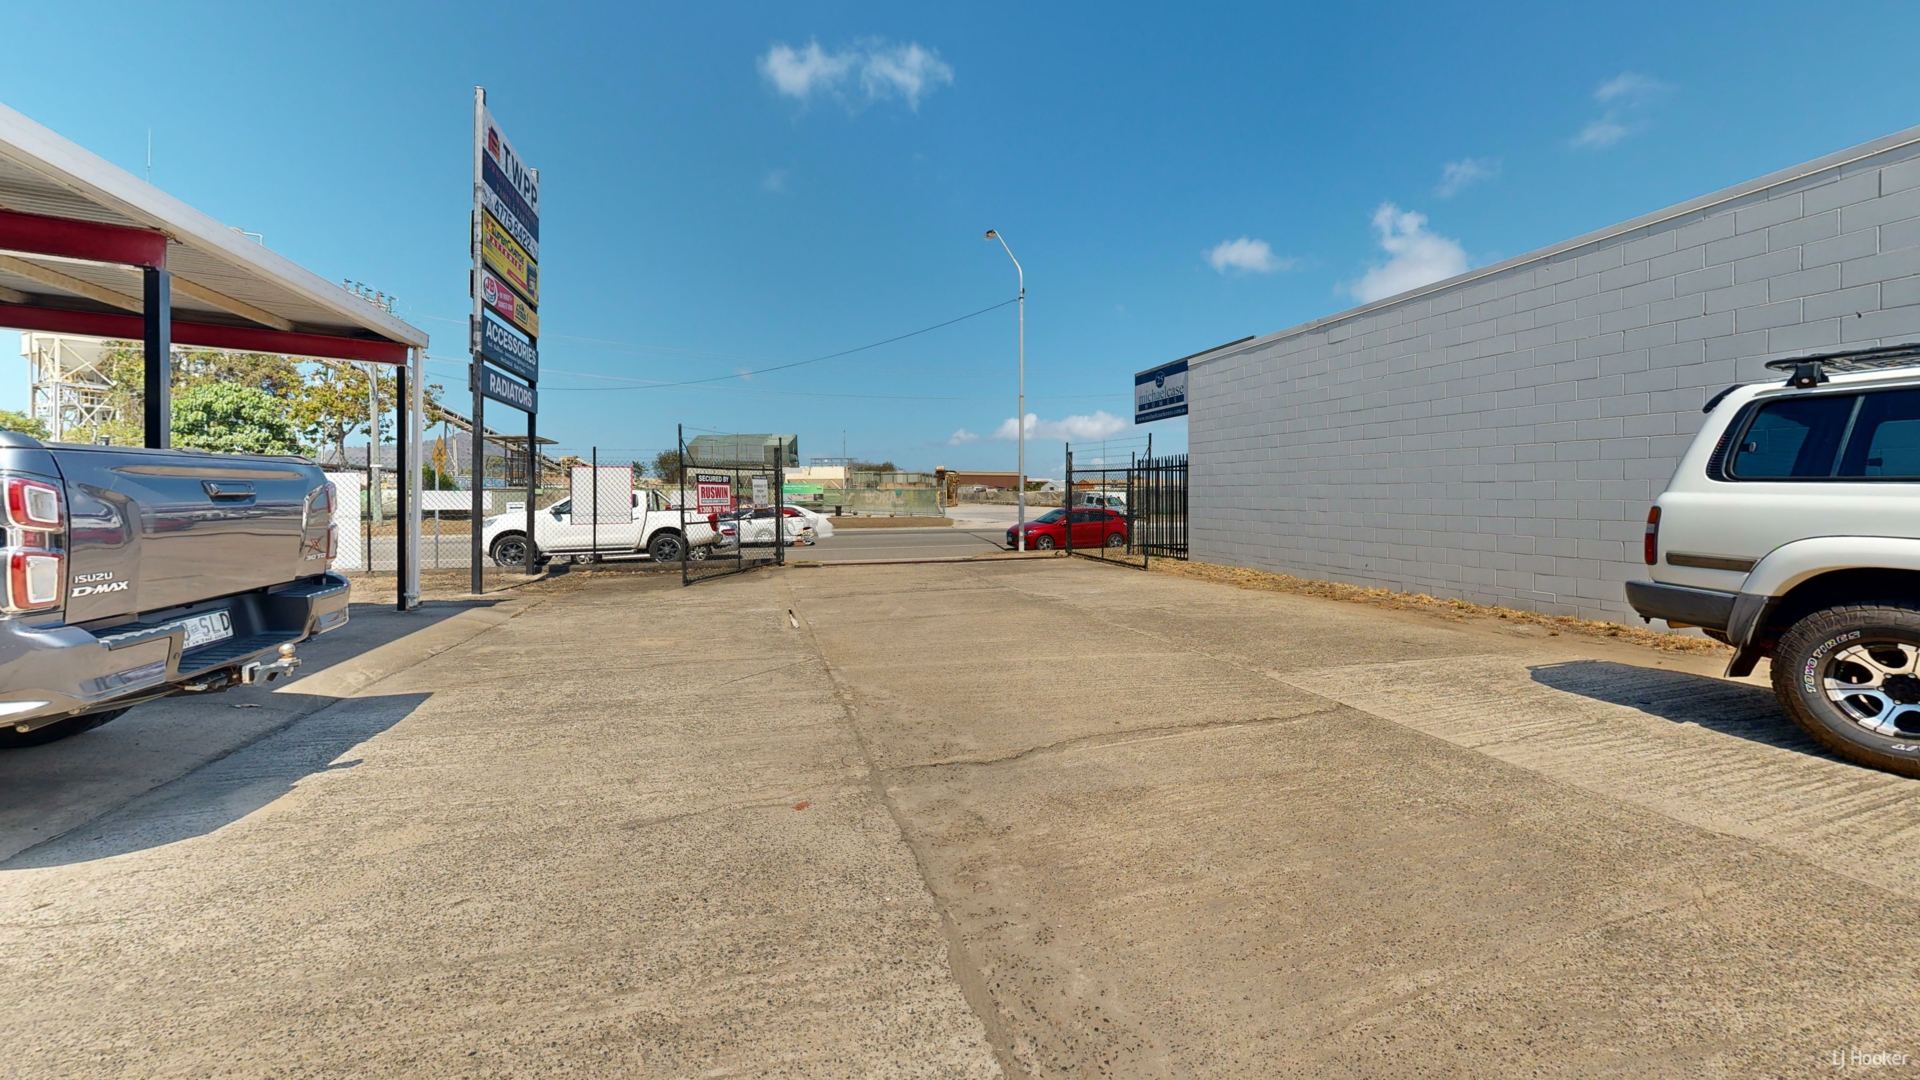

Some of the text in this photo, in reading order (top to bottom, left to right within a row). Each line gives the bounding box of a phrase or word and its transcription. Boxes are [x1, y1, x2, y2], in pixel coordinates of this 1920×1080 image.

[503, 142, 537, 208] TWPP
[495, 199, 513, 231] 4775
[514, 220, 531, 252] 6422
[486, 232, 524, 273] BATTERIES
[486, 320, 536, 366] ACCESSORIES
[489, 373, 533, 408] RADIATORS
[698, 475, 722, 483] SECURED
[701, 487, 728, 499] RUSWIN
[71, 580, 129, 598] D-MAX
[74, 571, 113, 584] ISUZU
[198, 612, 231, 637] SLD
[1804, 630, 1861, 693] TOYO TIRES
